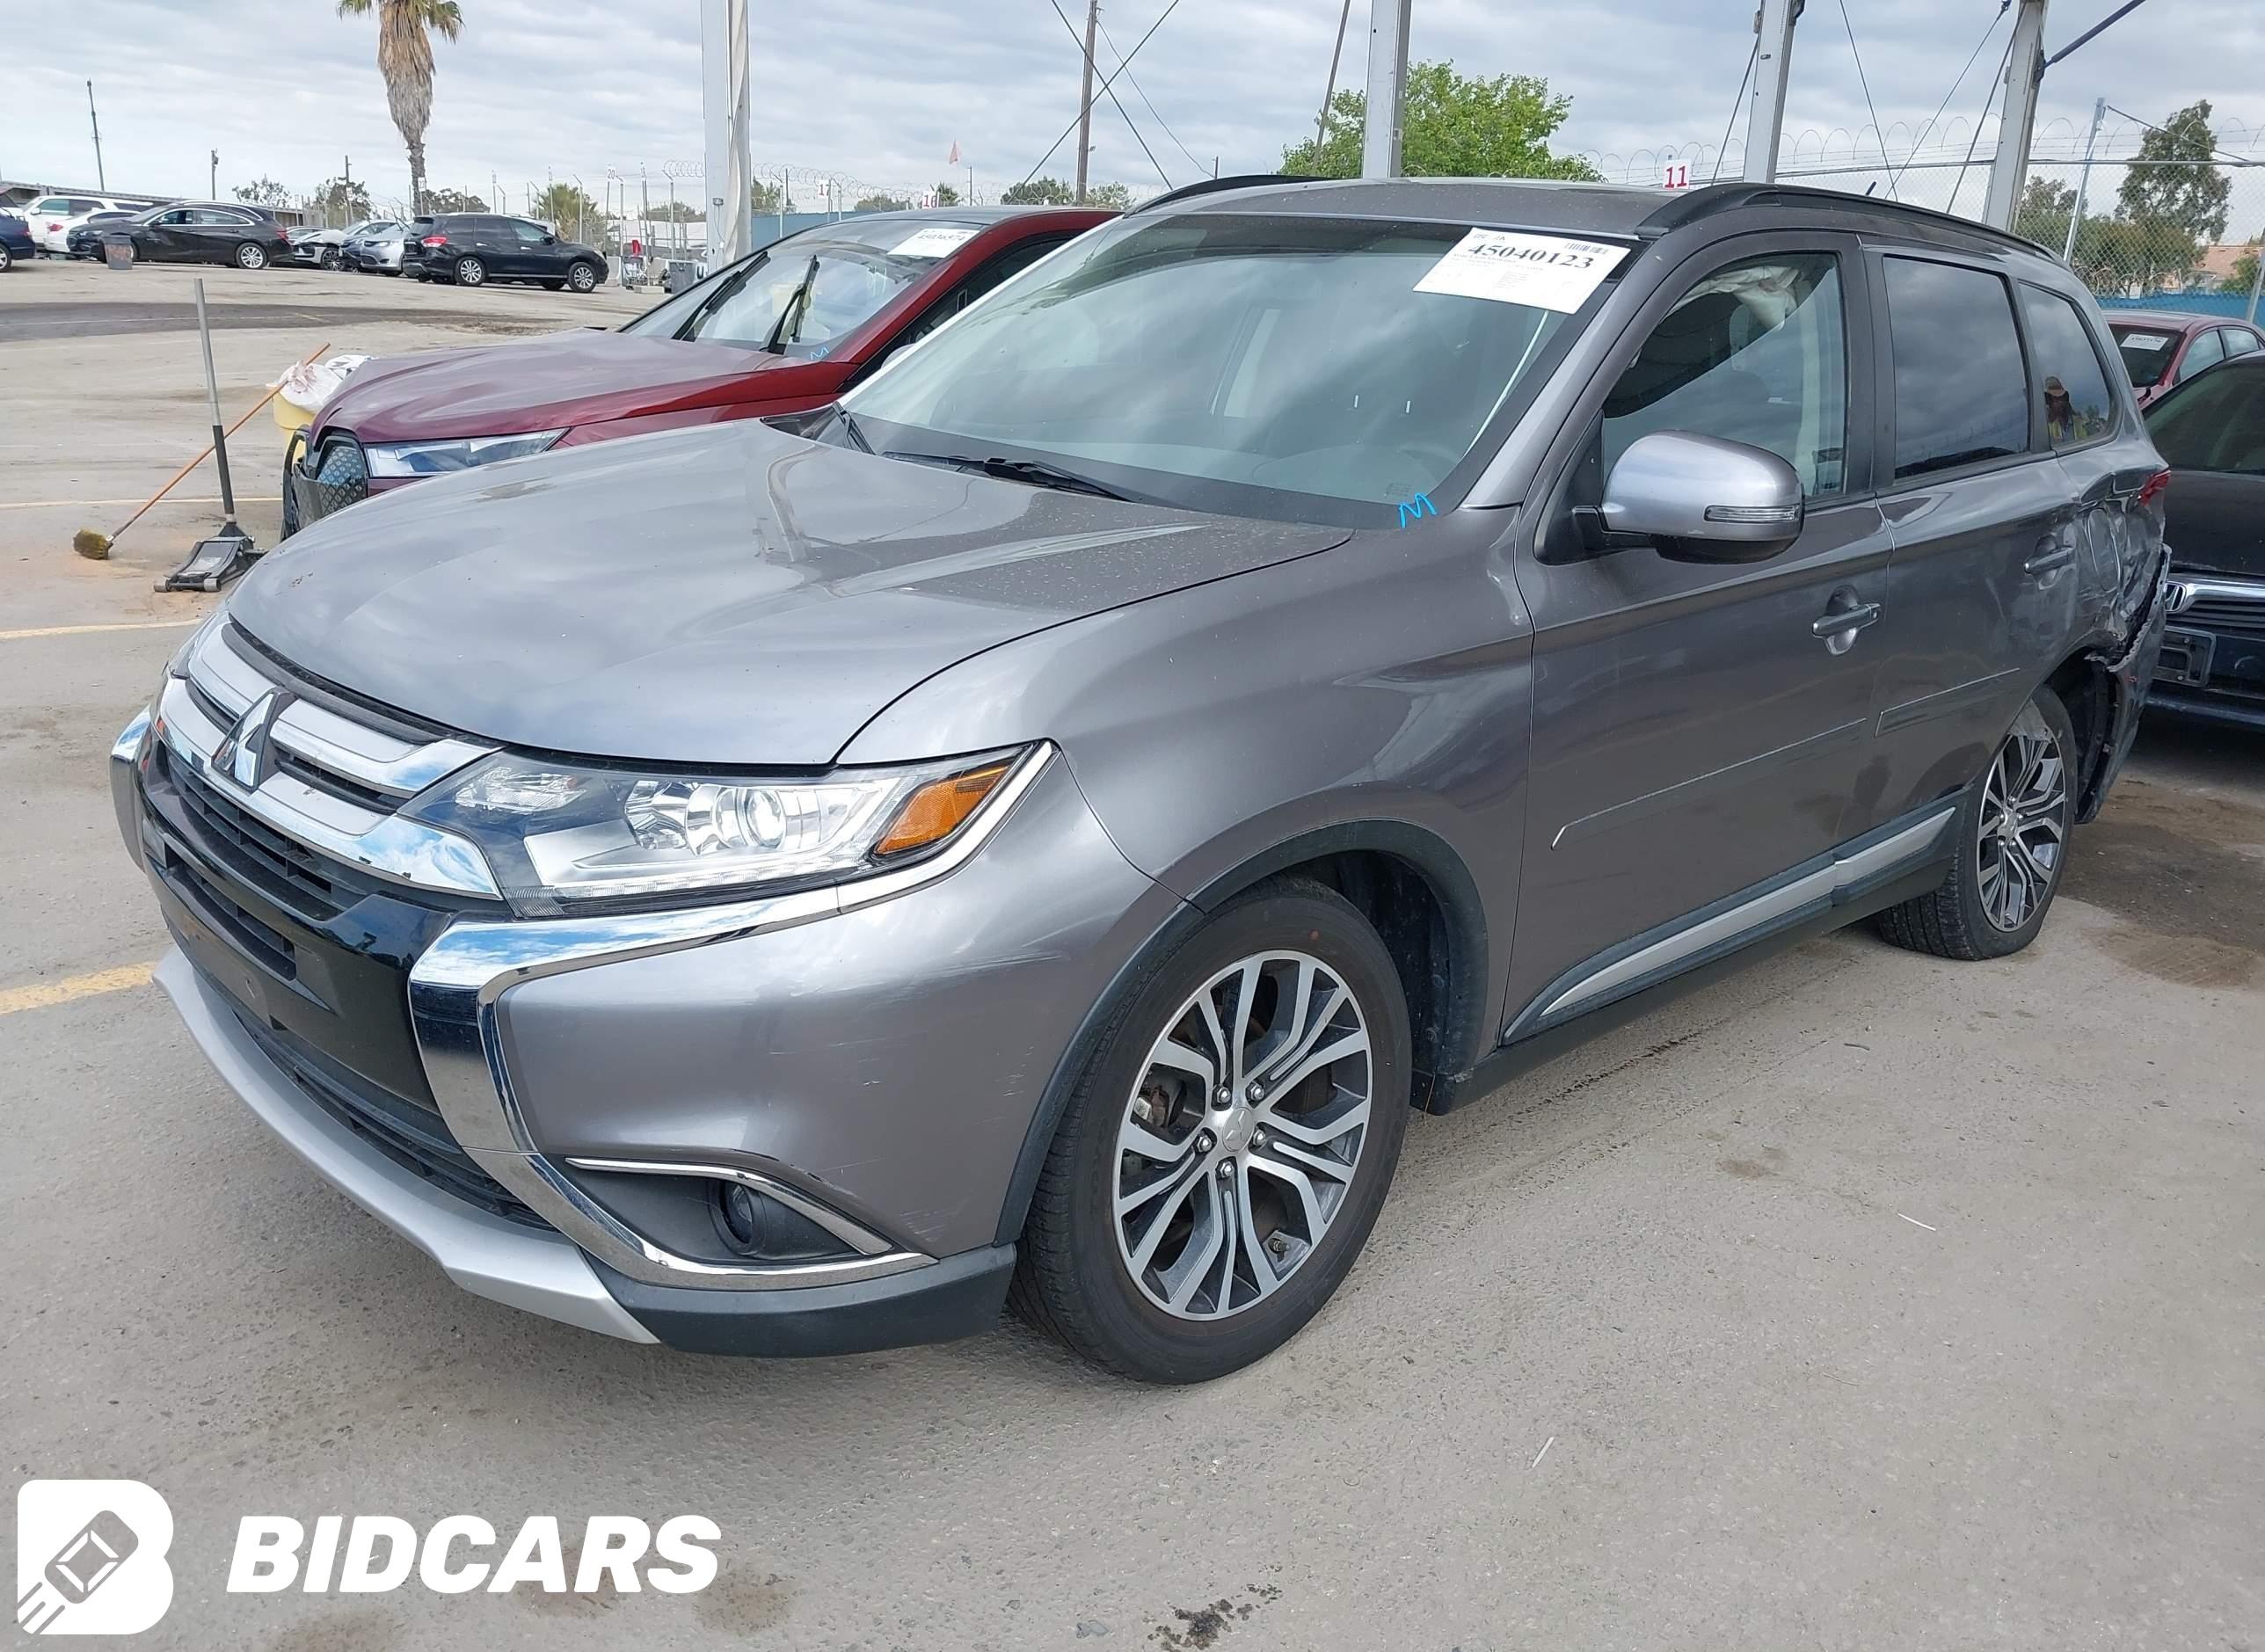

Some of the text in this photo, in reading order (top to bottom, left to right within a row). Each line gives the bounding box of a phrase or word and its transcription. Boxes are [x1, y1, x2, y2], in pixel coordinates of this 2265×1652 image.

[1664, 165, 1687, 188] 11
[1468, 243, 1595, 270] 45040123
[1398, 492, 1438, 528] M
